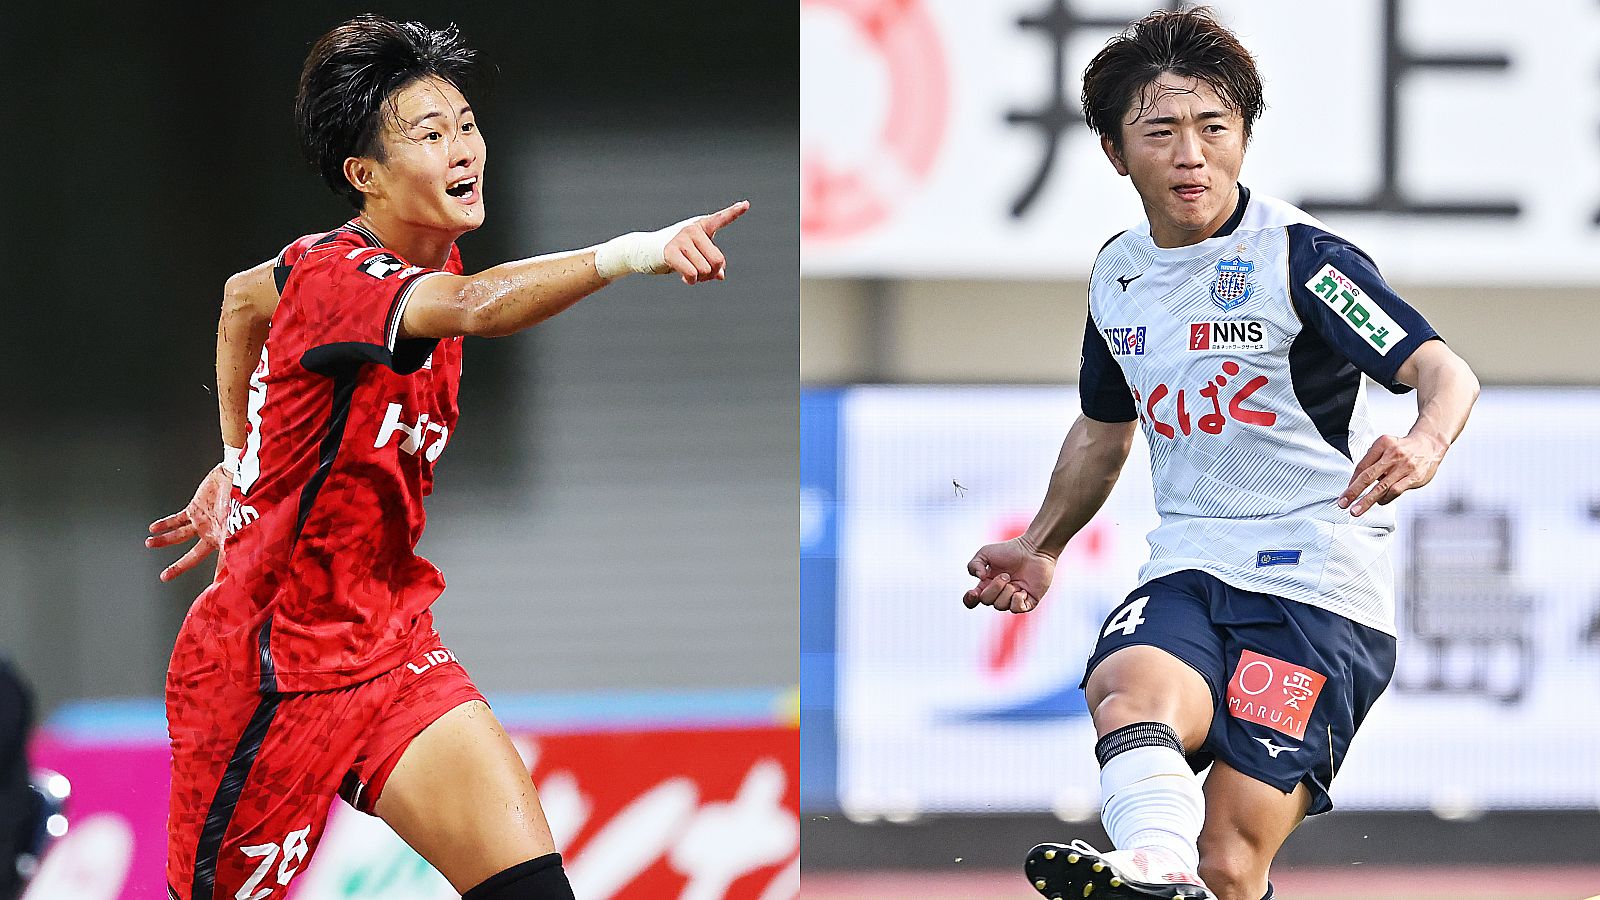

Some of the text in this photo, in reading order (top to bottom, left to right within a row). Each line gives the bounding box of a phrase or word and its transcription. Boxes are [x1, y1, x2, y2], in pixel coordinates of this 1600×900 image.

[1213, 321, 1263, 343] NNS
[1133, 360, 1277, 440] くばく
[1228, 696, 1302, 733] MARUAI
[234, 823, 311, 900] 28
